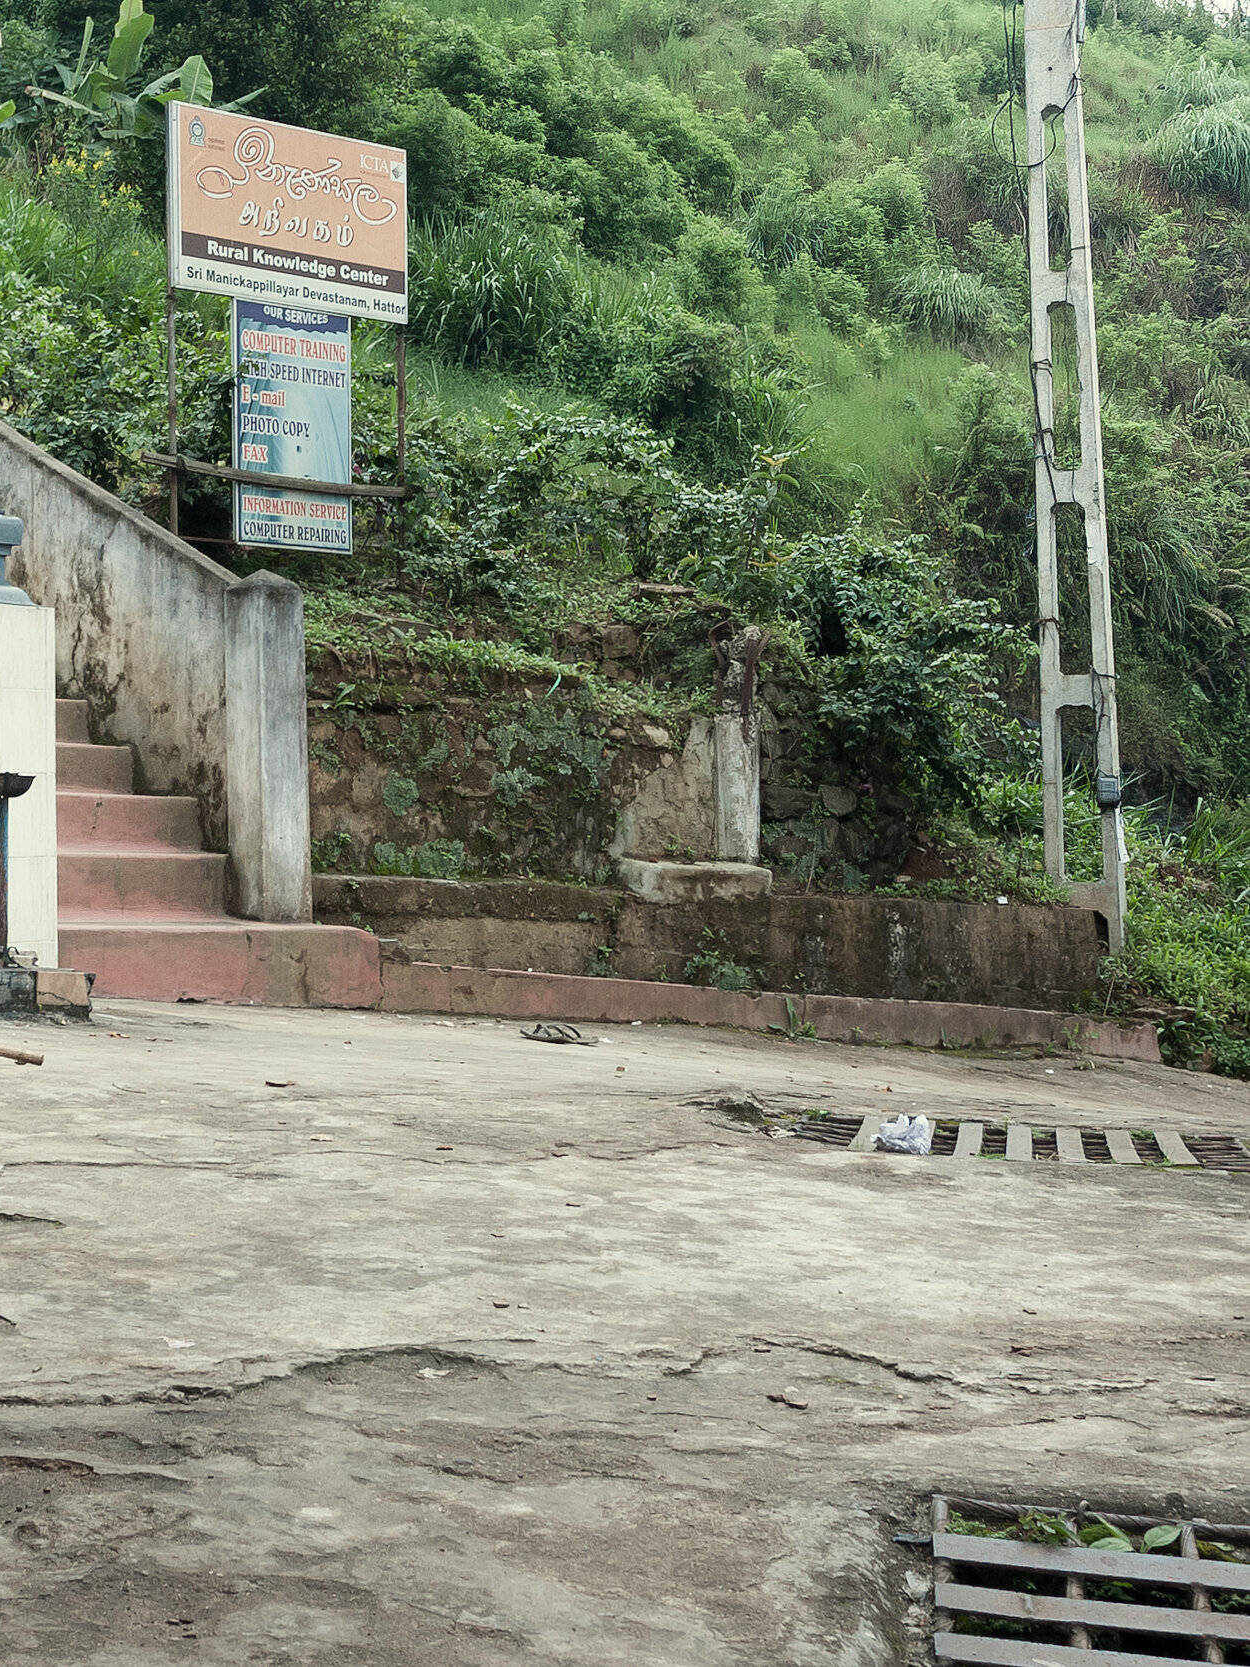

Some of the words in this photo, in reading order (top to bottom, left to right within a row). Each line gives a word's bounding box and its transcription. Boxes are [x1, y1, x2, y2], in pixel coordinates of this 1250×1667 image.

[359, 153, 389, 174] ICTA
[238, 196, 354, 247] அறிவகம்
[207, 240, 249, 261] Rural
[253, 248, 336, 279] Knowledge
[340, 264, 389, 286] Center
[187, 266, 202, 280] Sri
[206, 269, 299, 298] Manickappillayar
[303, 287, 371, 312] Devastanam,
[263, 305, 283, 320] OUR
[284, 309, 329, 325] SERVICES
[242, 330, 297, 355] COMPUTER
[299, 339, 346, 362] TRAINING
[270, 362, 299, 382] SPEED
[302, 367, 346, 389] INTERNET
[242, 385, 250, 402] E
[261, 391, 285, 406] mail
[243, 415, 280, 434] PHOTO
[282, 420, 310, 438] COPY
[243, 444, 267, 462] FAX
[243, 496, 307, 517] INFORMATION
[309, 503, 347, 521] SERVICE
[243, 521, 295, 540] COMPUTER
[297, 526, 347, 544] REPAIRING
